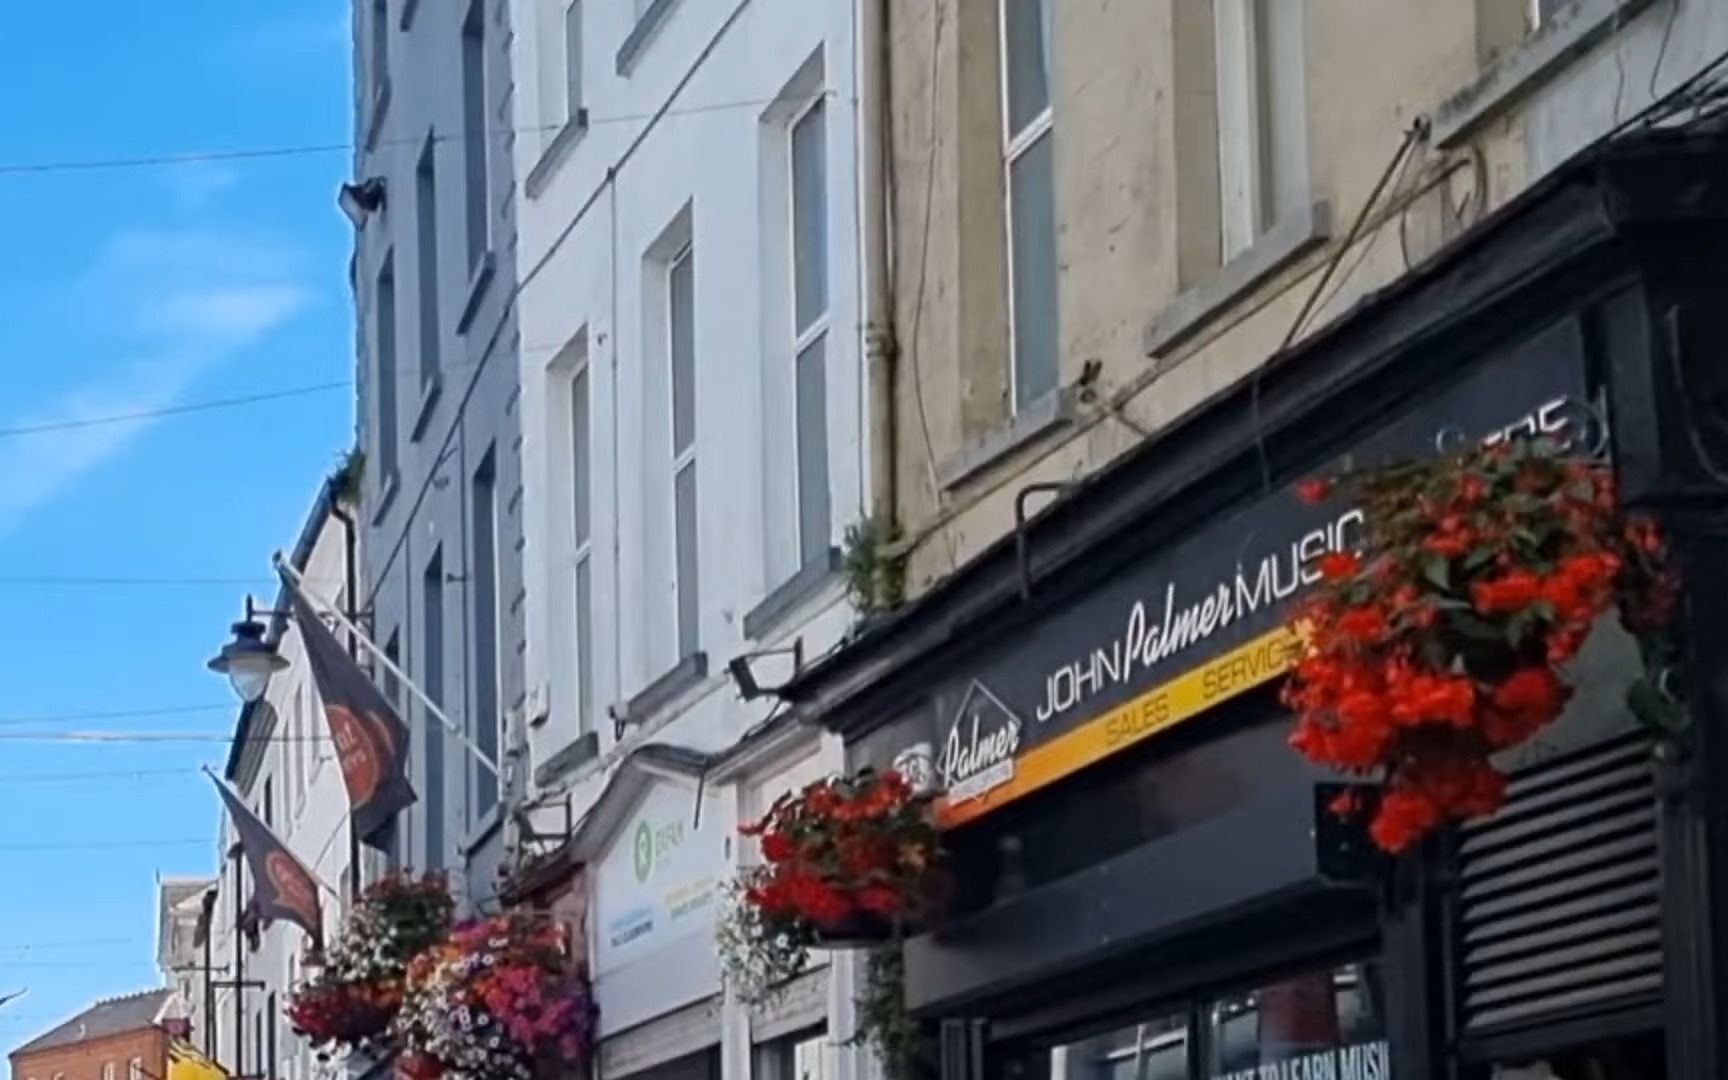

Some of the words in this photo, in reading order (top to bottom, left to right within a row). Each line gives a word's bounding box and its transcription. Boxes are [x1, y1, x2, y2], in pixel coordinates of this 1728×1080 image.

[1036, 640, 1120, 722] JOHN
[1123, 582, 1235, 683] Palmer
[1104, 694, 1170, 747] SALES
[1201, 635, 1300, 699] SERVIC
[935, 714, 1020, 788] Palmer
